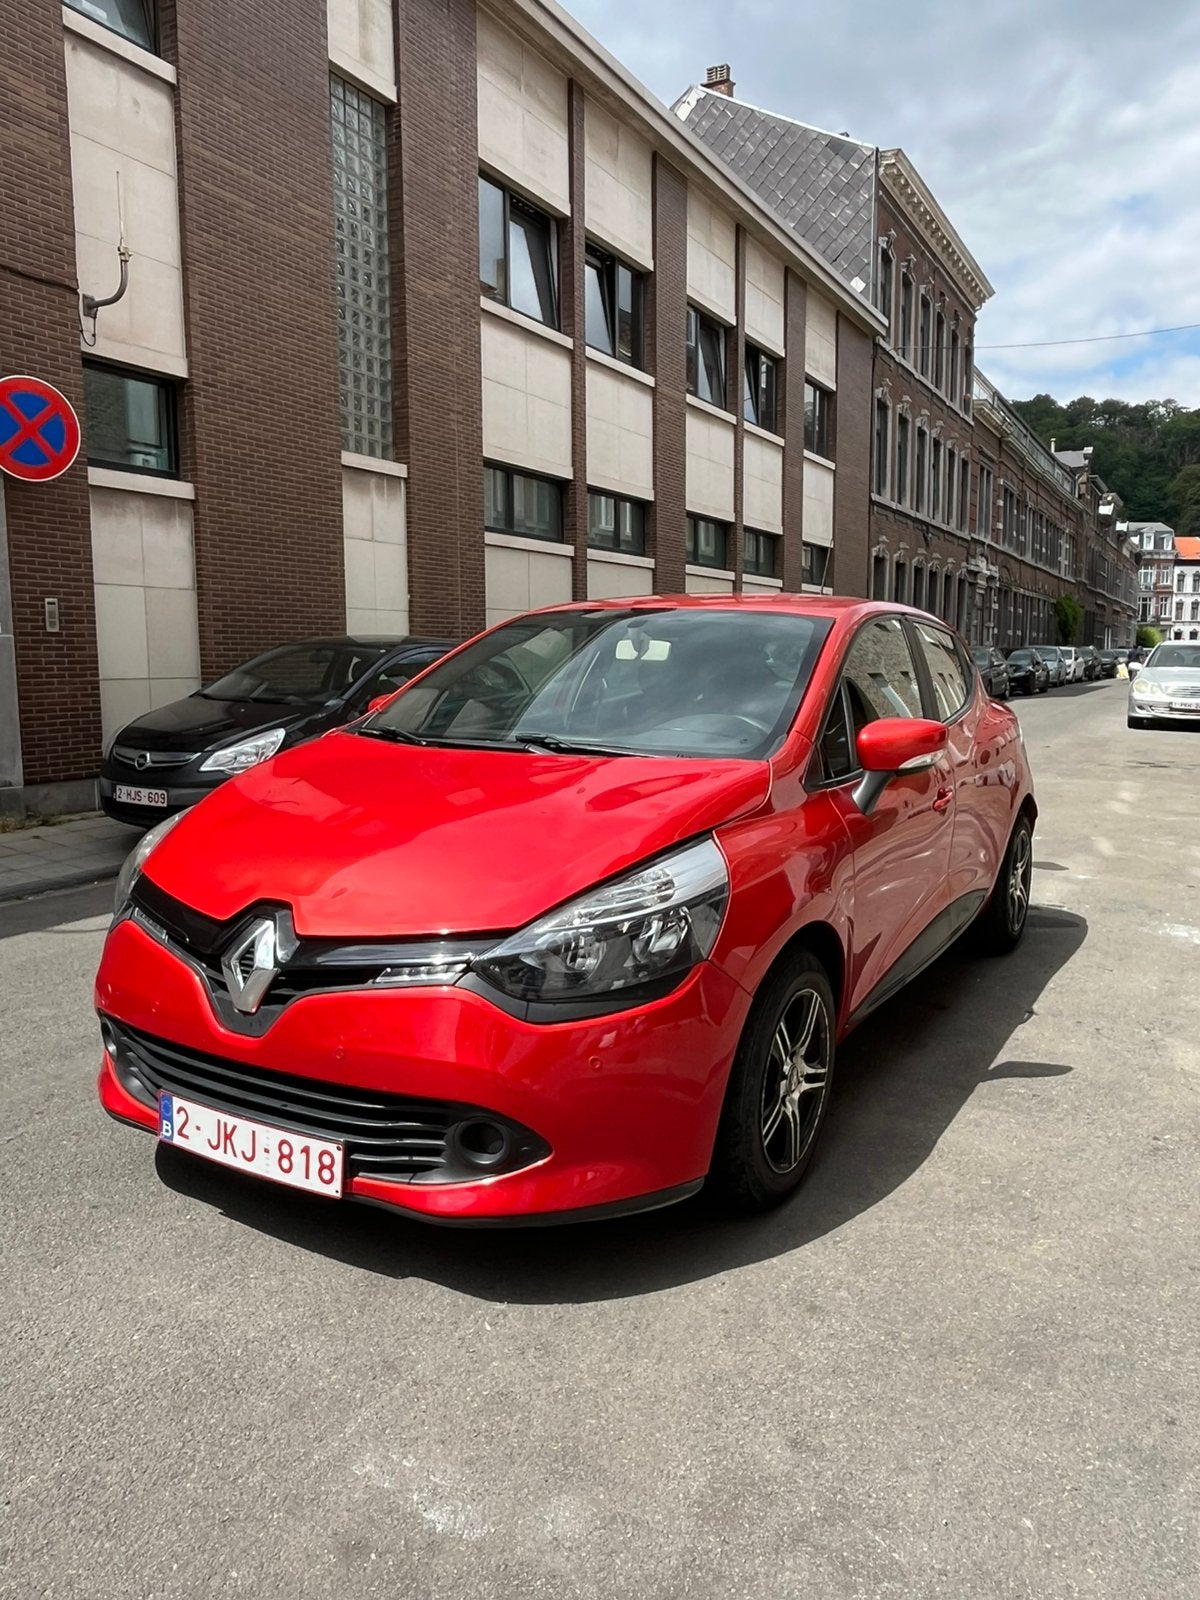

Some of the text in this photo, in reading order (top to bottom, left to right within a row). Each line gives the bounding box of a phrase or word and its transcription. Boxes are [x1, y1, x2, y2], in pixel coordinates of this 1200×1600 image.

[117, 788, 166, 804] 2-HJS-609
[163, 1107, 336, 1185] B 2-JKJ-818
